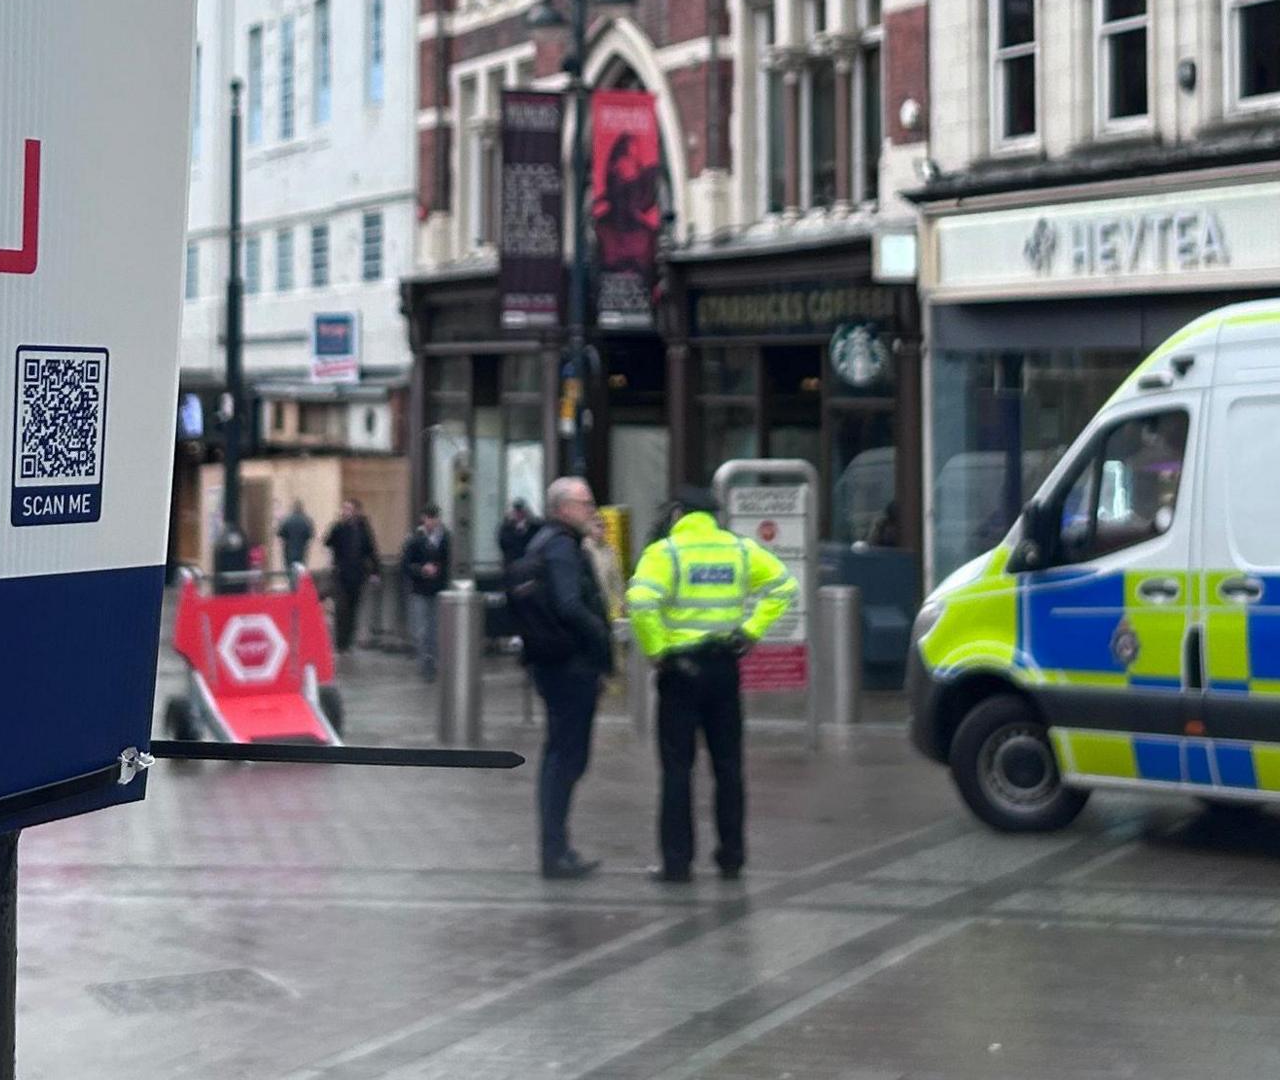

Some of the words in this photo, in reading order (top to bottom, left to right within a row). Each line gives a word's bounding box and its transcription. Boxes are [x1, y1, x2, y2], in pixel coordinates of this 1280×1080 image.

[1071, 211, 1230, 275] HEYTEA
[22, 494, 65, 517] SCAN
[68, 493, 92, 514] ME
